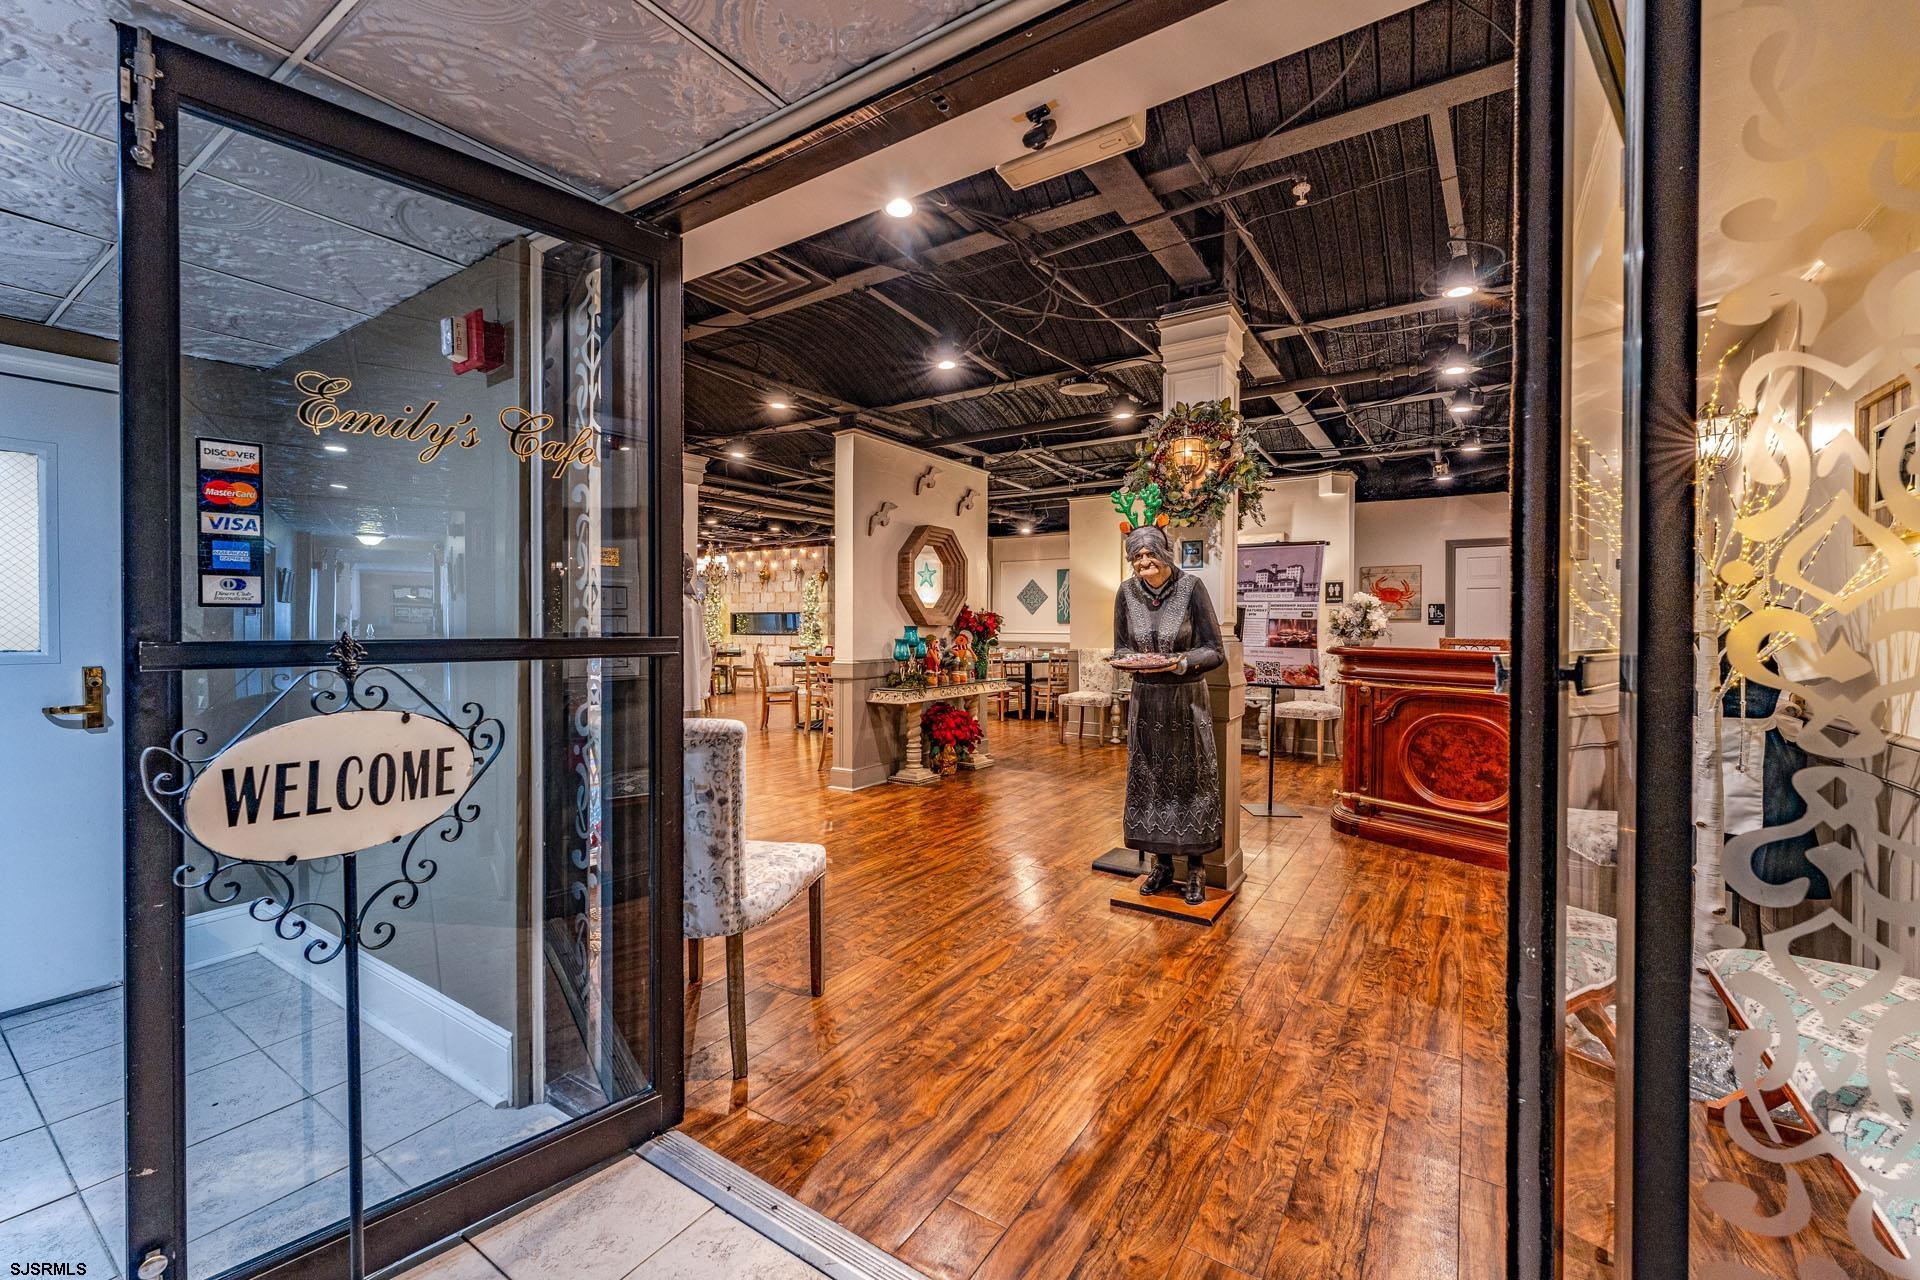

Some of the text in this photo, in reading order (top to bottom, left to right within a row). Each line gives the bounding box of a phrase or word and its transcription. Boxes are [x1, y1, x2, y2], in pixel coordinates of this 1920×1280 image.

[294, 370, 597, 479] Emily's Cafe
[203, 447, 257, 460] DISCOVER
[205, 487, 256, 499] MasterCard
[208, 514, 259, 532] VISA
[221, 746, 456, 828] WELCOME
